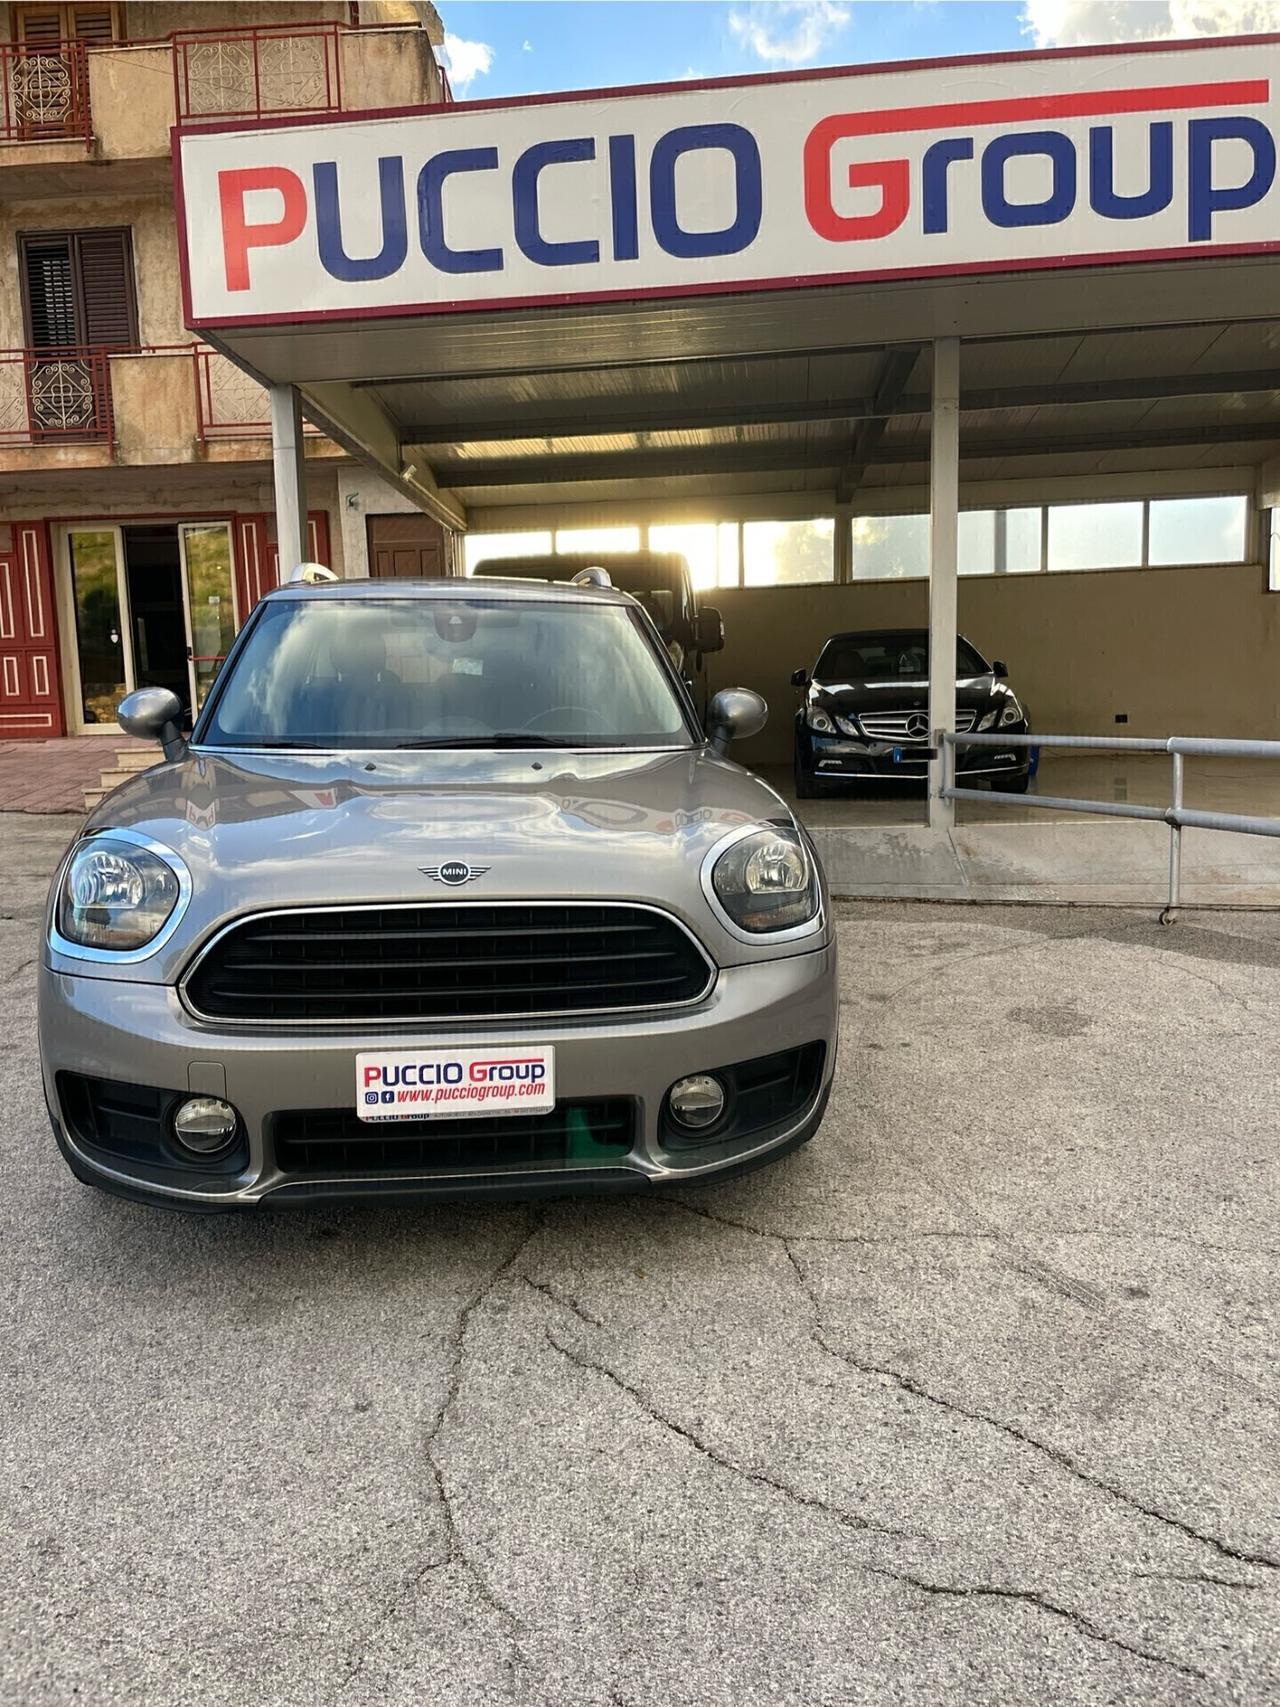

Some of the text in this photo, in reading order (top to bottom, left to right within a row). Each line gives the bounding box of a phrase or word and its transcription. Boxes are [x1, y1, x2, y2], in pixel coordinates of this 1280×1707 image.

[218, 79, 1276, 291] PUCCIO Group
[442, 868, 467, 876] MINI
[364, 1058, 545, 1088] PUCCIO Group
[397, 1083, 545, 1104] www.pucciogroup.com
